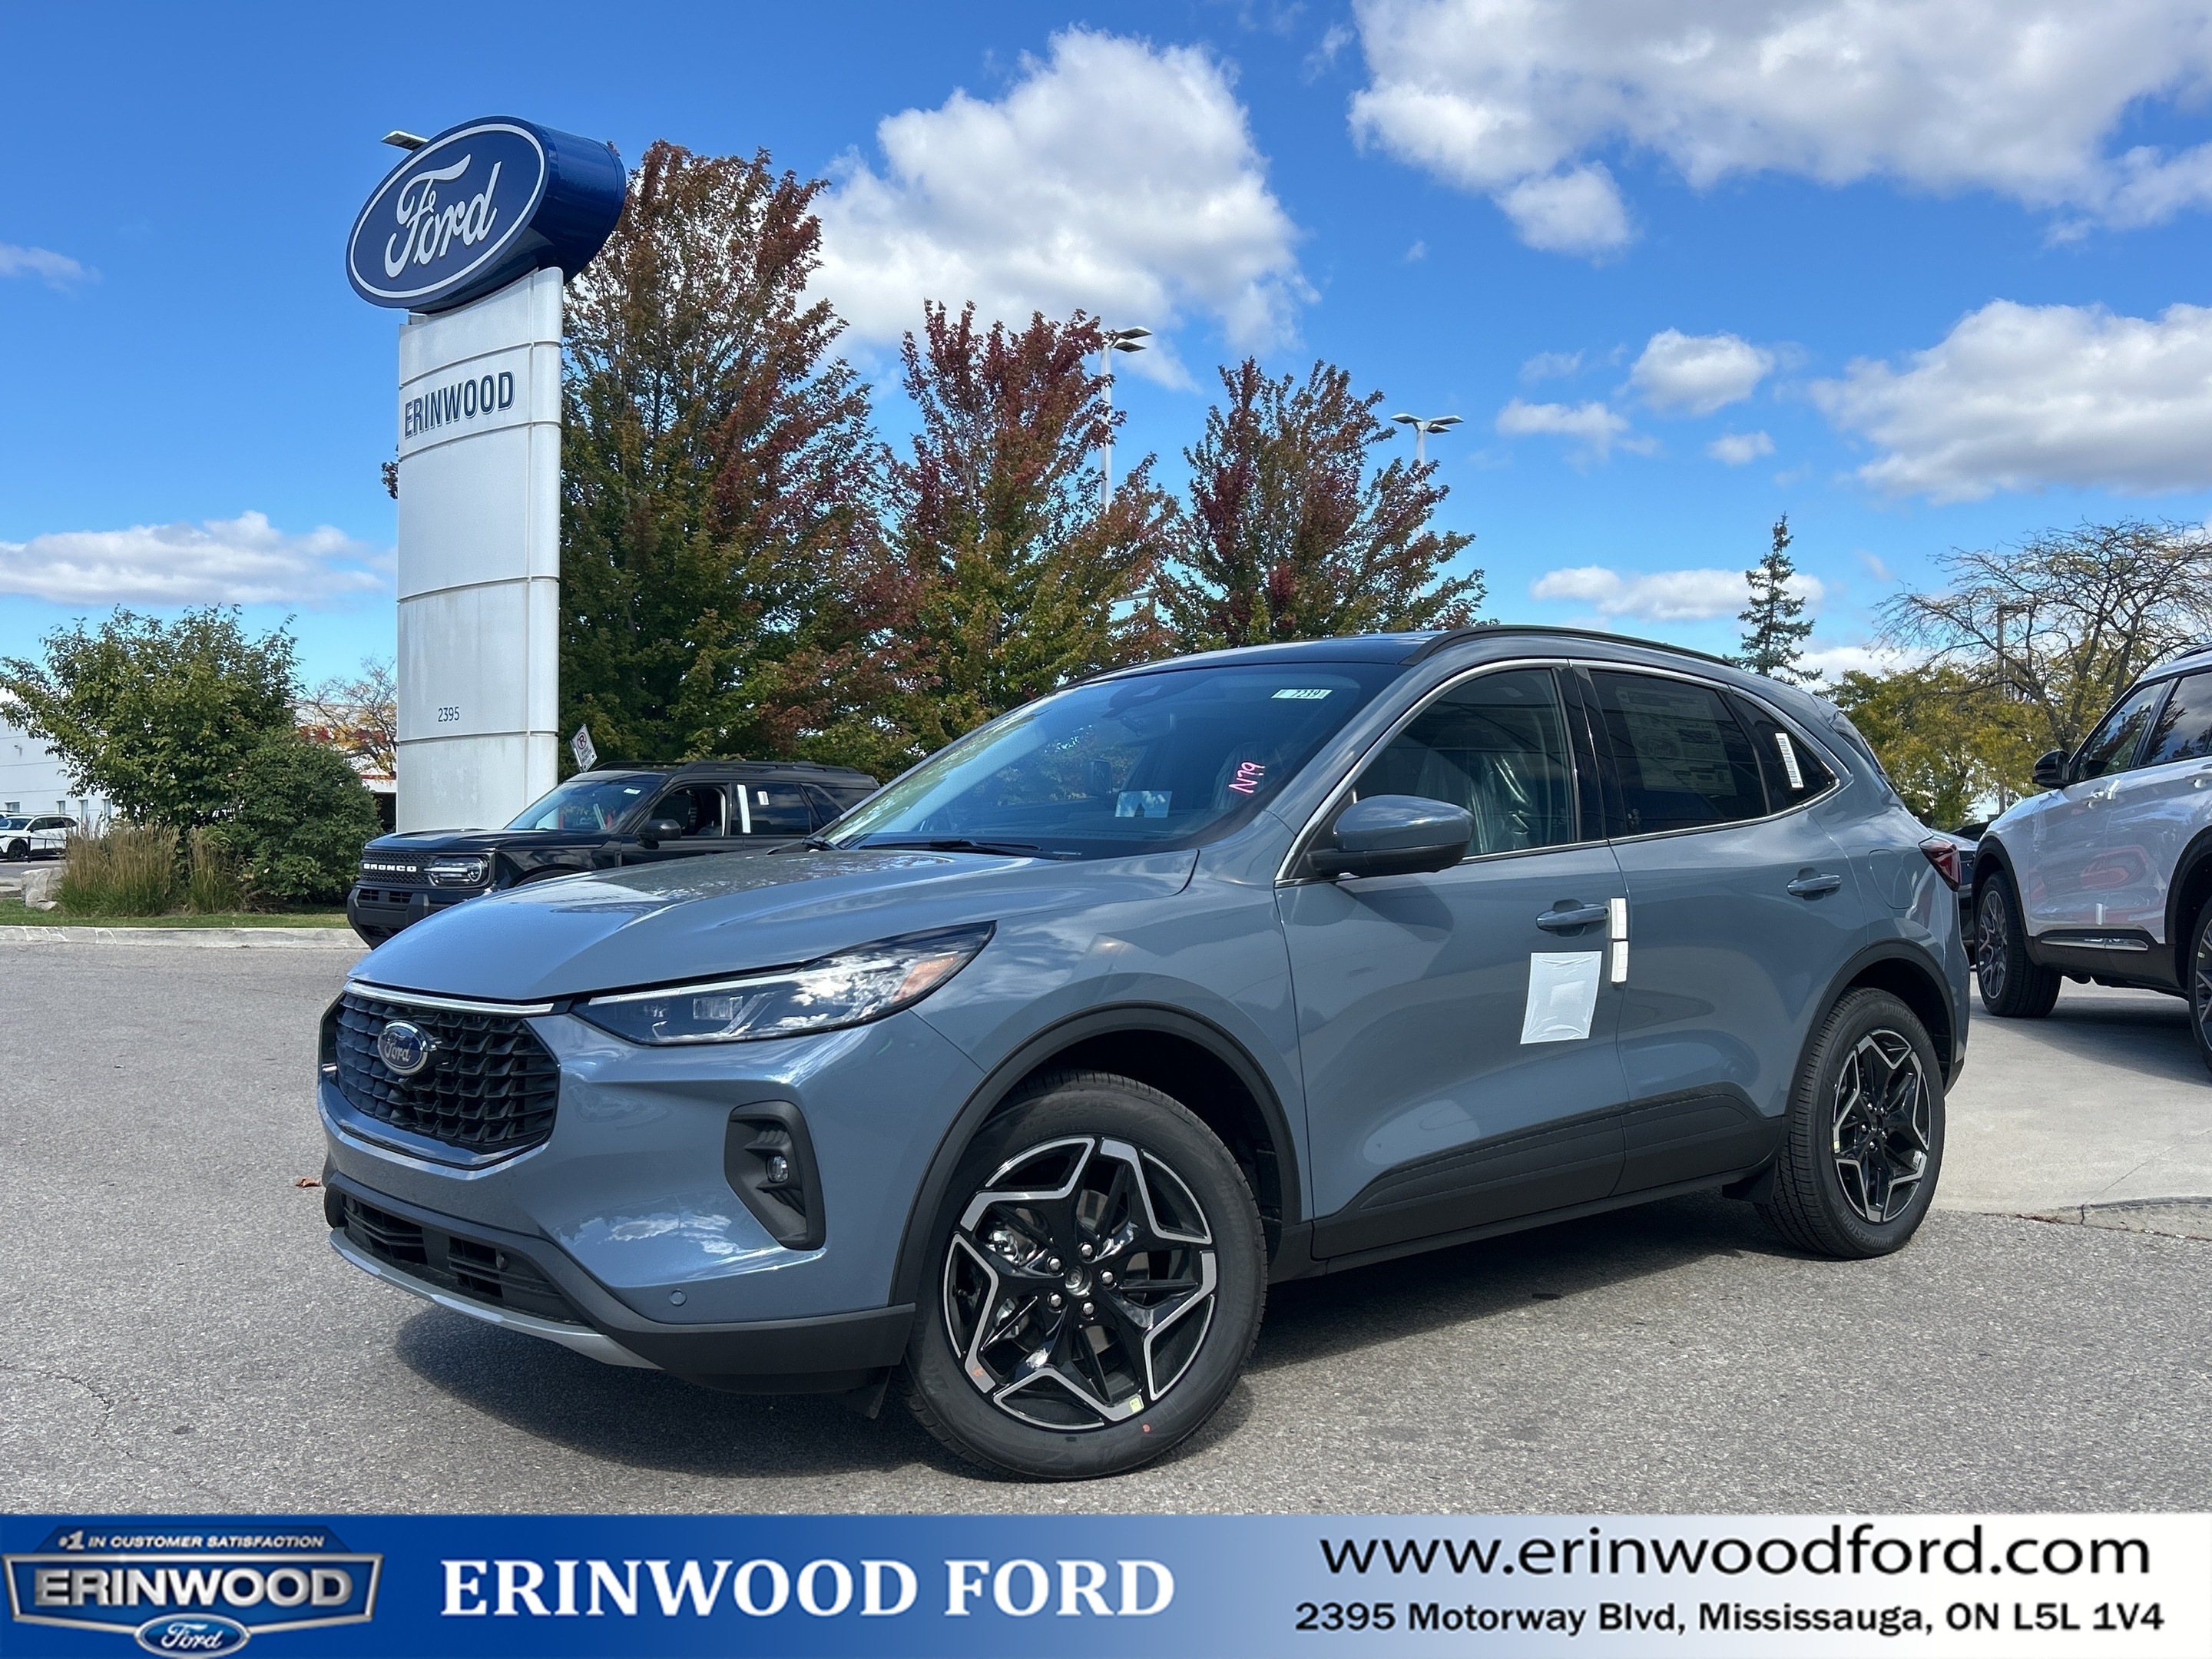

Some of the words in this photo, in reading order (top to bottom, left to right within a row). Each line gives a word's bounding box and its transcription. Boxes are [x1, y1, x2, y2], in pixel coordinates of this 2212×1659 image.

[385, 153, 502, 278] Ford
[404, 371, 515, 439] ERINWOOD
[438, 706, 460, 722] 2395
[363, 863, 417, 873] BRONCO
[383, 1031, 413, 1062] Ford
